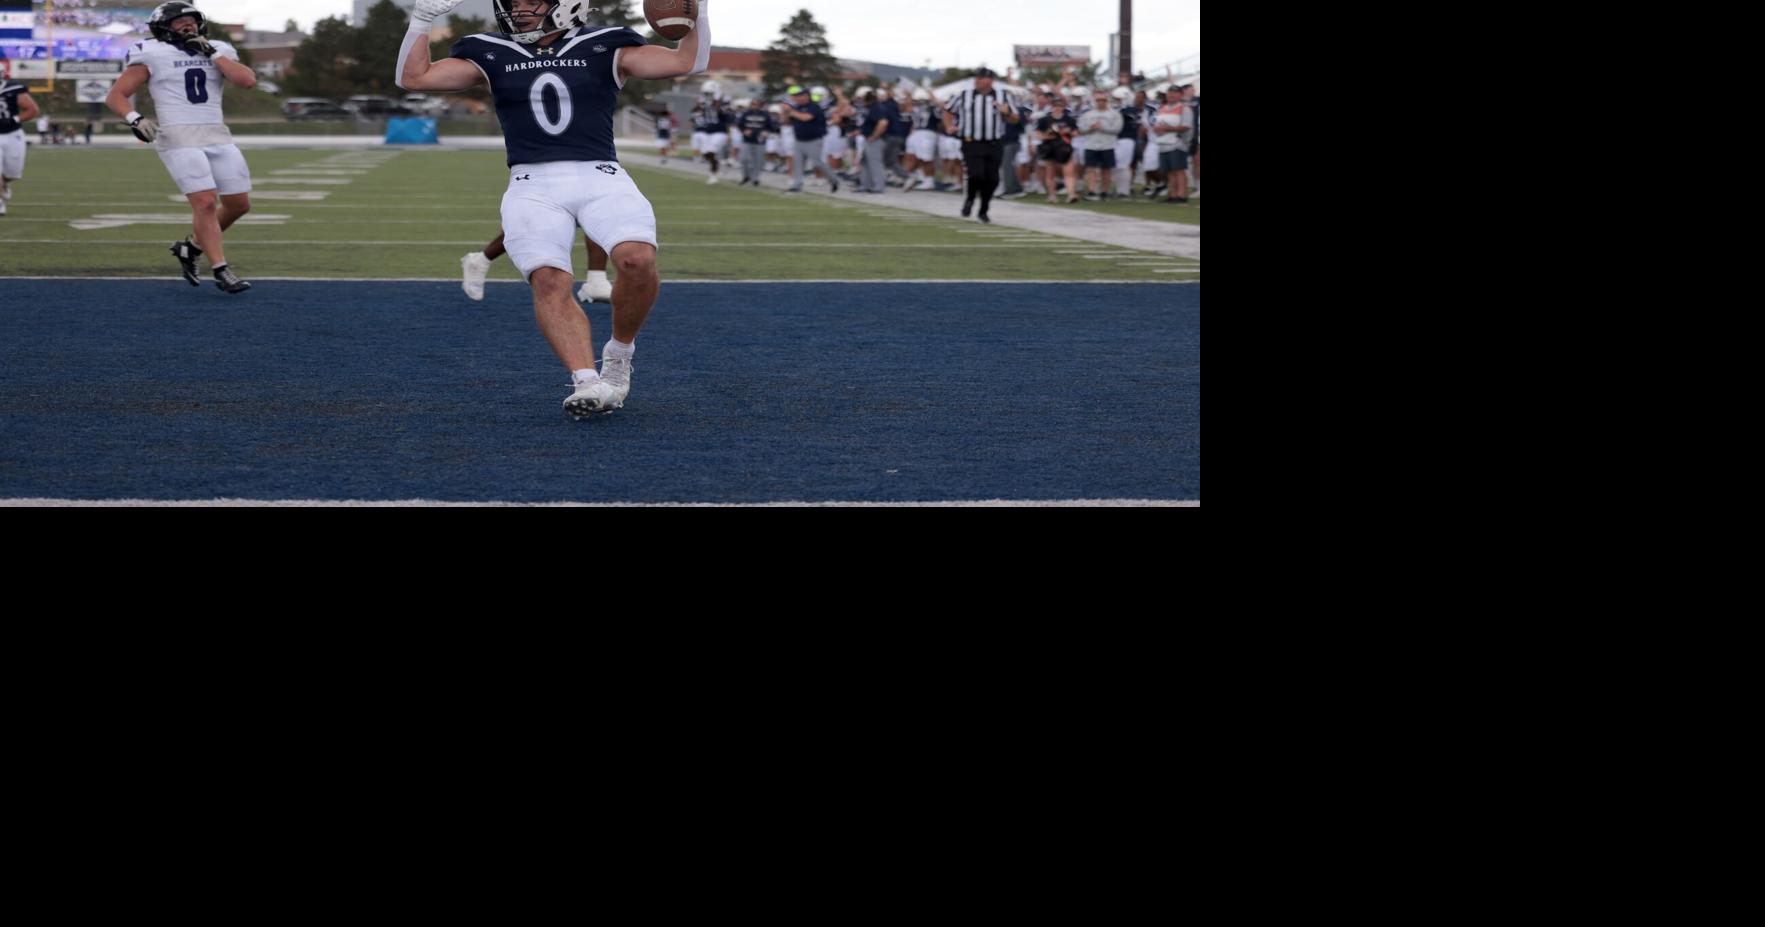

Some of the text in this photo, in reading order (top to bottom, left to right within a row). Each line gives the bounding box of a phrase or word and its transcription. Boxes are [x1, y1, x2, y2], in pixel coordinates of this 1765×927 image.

[173, 59, 214, 68] BEARCATS
[505, 59, 587, 72] HARDROCKERS
[184, 68, 208, 104] 0
[529, 72, 573, 136] 0
